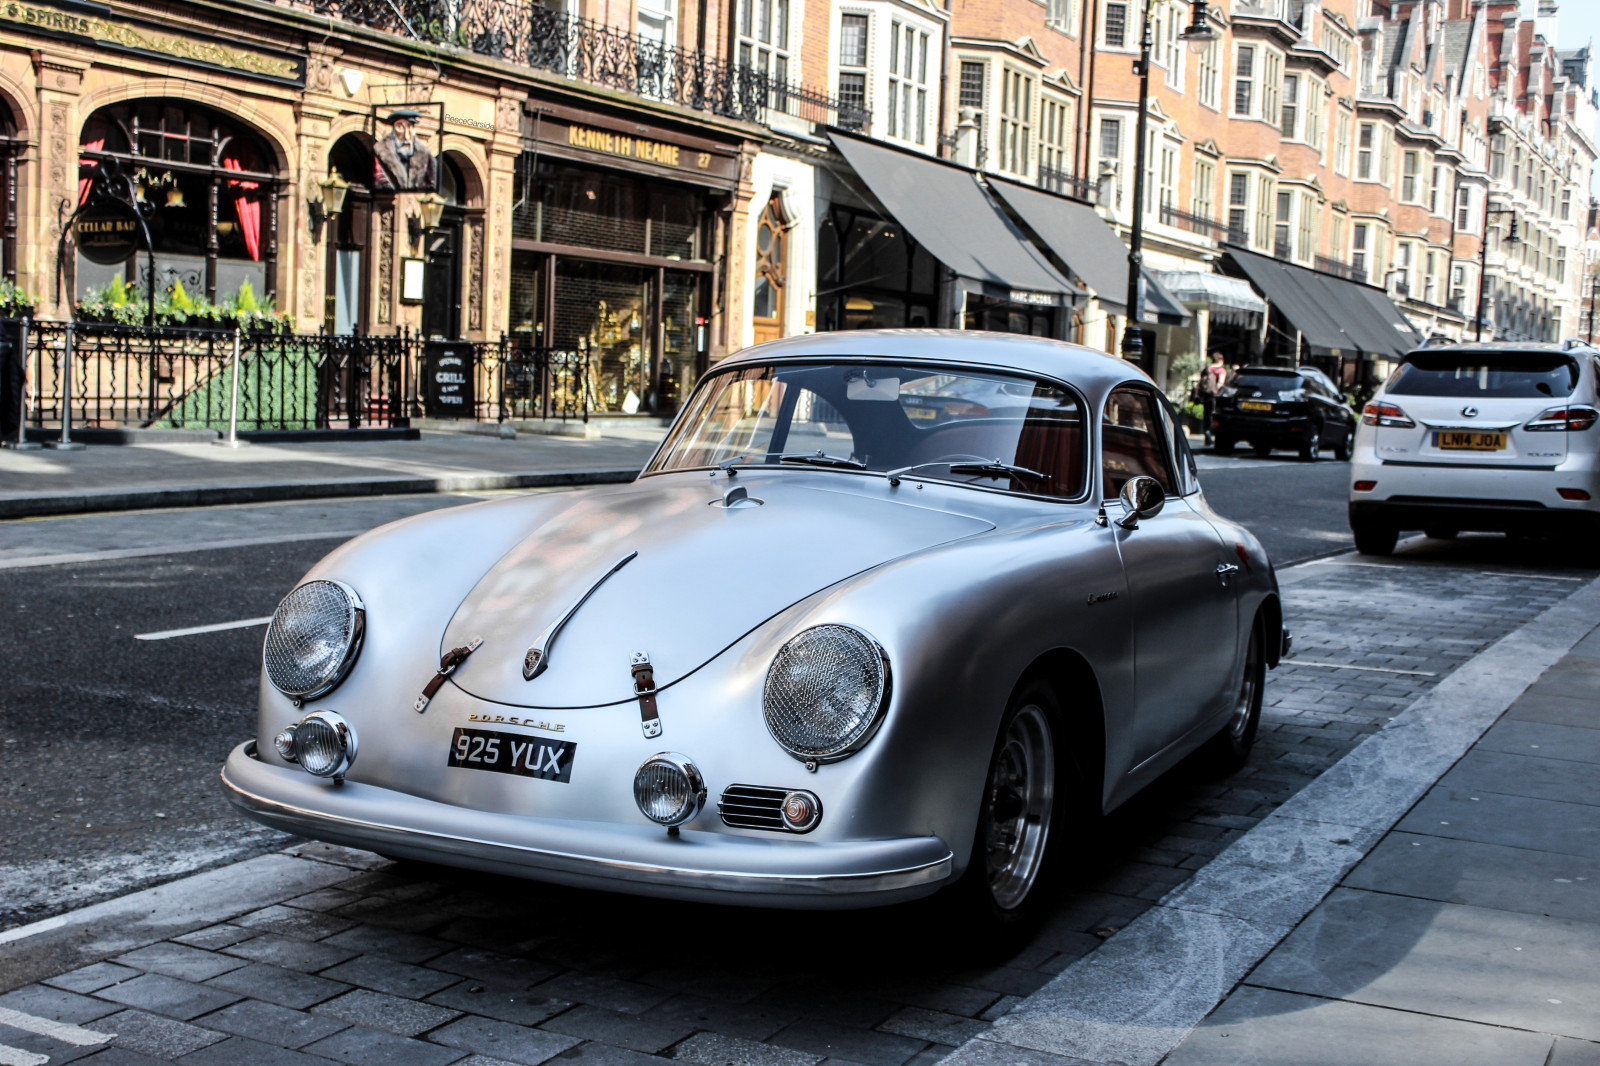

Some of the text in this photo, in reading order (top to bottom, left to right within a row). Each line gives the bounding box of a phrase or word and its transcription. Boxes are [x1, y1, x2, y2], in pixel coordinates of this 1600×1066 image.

[25, 7, 89, 33] SPIRITS
[568, 125, 712, 169] KENNETH NEAME 27
[77, 220, 136, 233] CELLAR BAR
[1441, 431, 1472, 446] LN14
[467, 713, 566, 732] PORSCHE
[455, 734, 565, 775] 925 YUX
